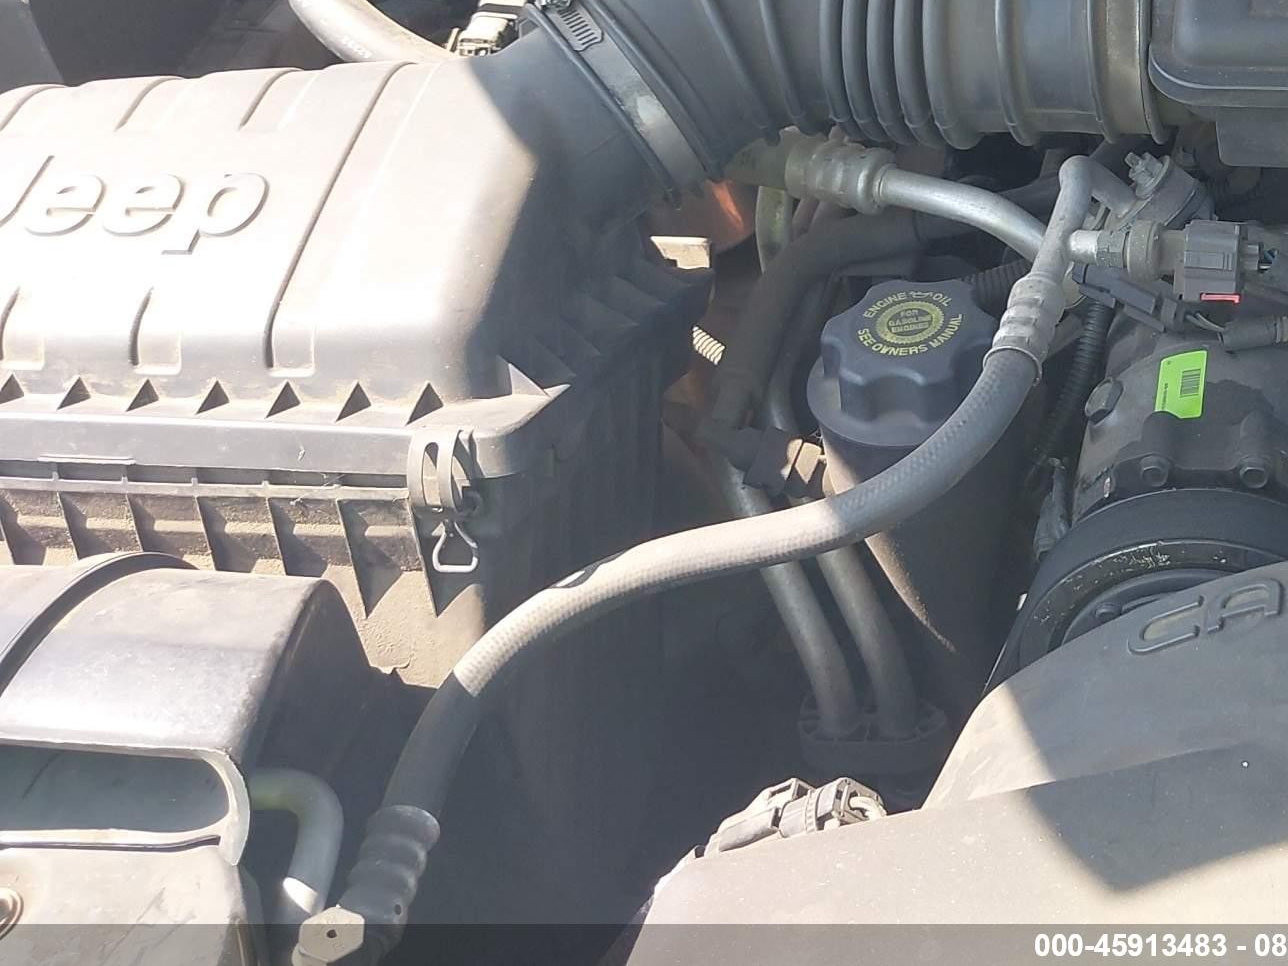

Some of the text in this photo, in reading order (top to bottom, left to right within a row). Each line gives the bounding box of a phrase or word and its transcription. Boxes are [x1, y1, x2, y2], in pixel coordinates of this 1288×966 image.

[863, 292, 953, 318] ENGINE OIL
[857, 314, 963, 356] SEE OWNERS MANUAL
